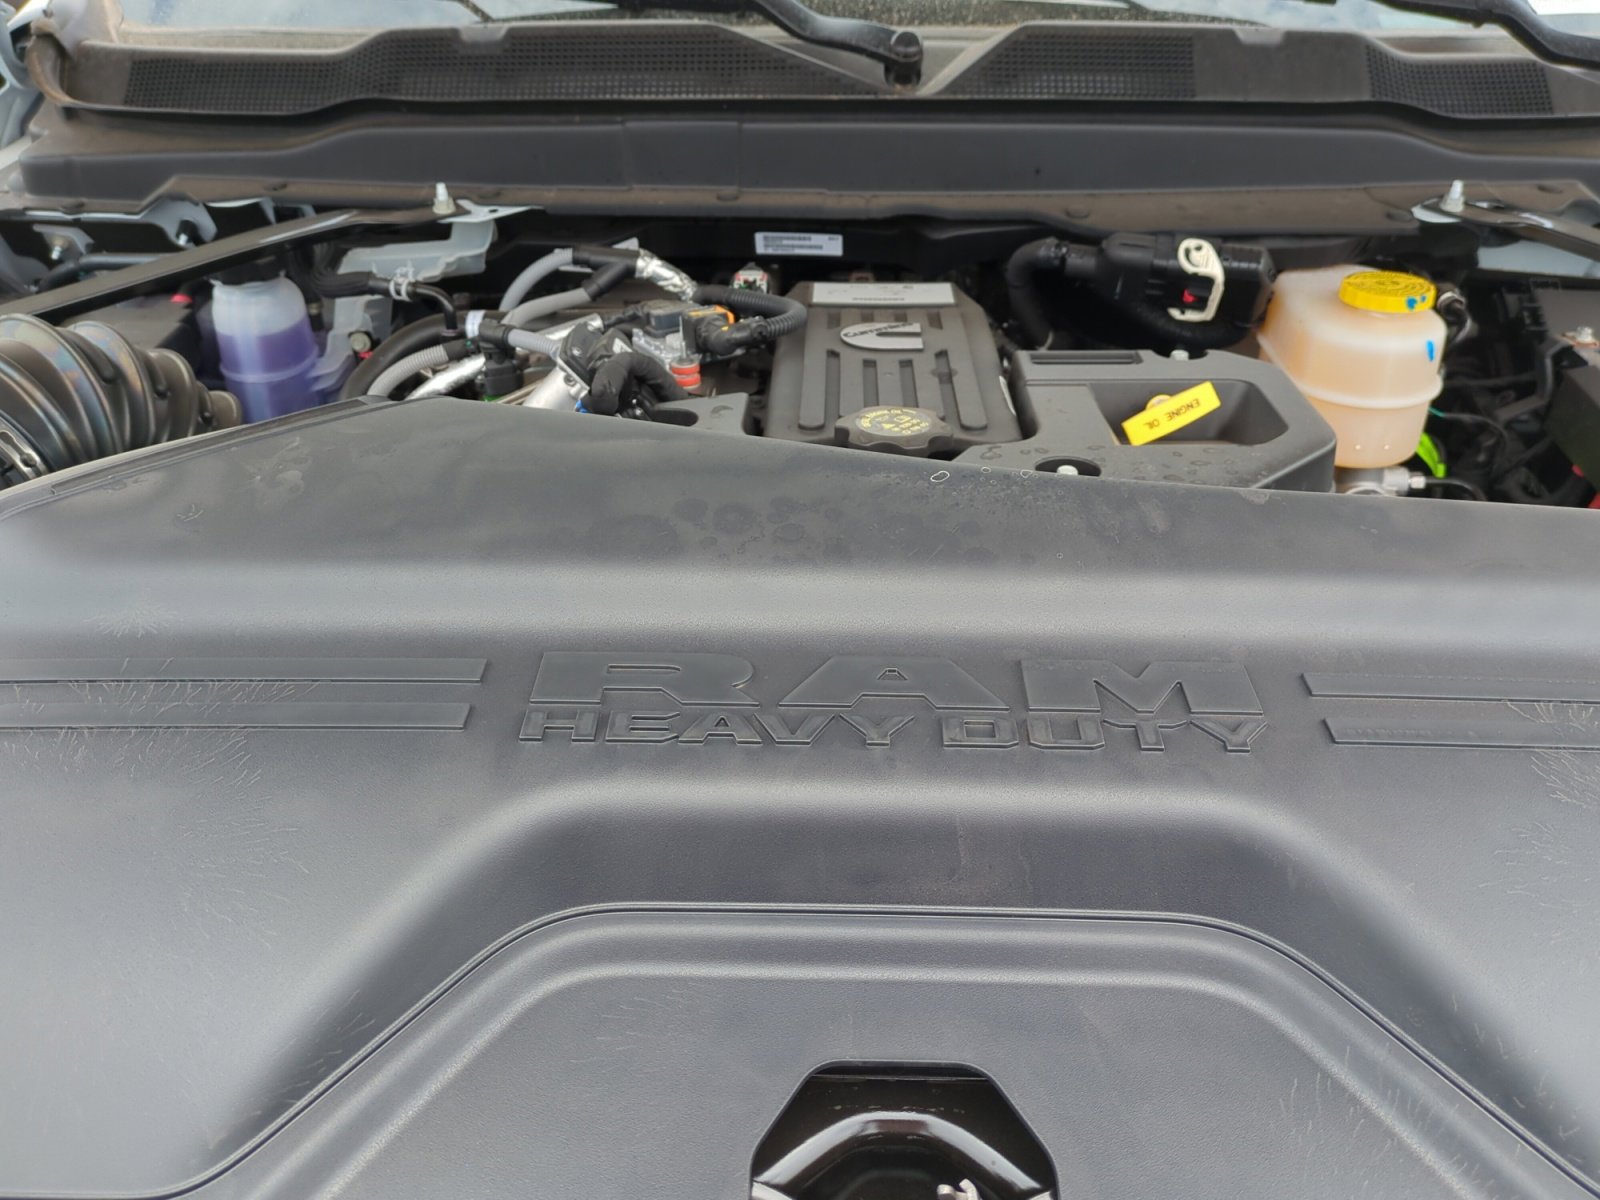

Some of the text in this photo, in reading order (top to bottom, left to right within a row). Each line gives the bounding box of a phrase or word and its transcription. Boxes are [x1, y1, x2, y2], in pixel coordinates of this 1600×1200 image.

[1164, 398, 1201, 422] ENGINE
[529, 651, 1264, 717] RAM
[518, 708, 1268, 753] HEAVY DUTY
